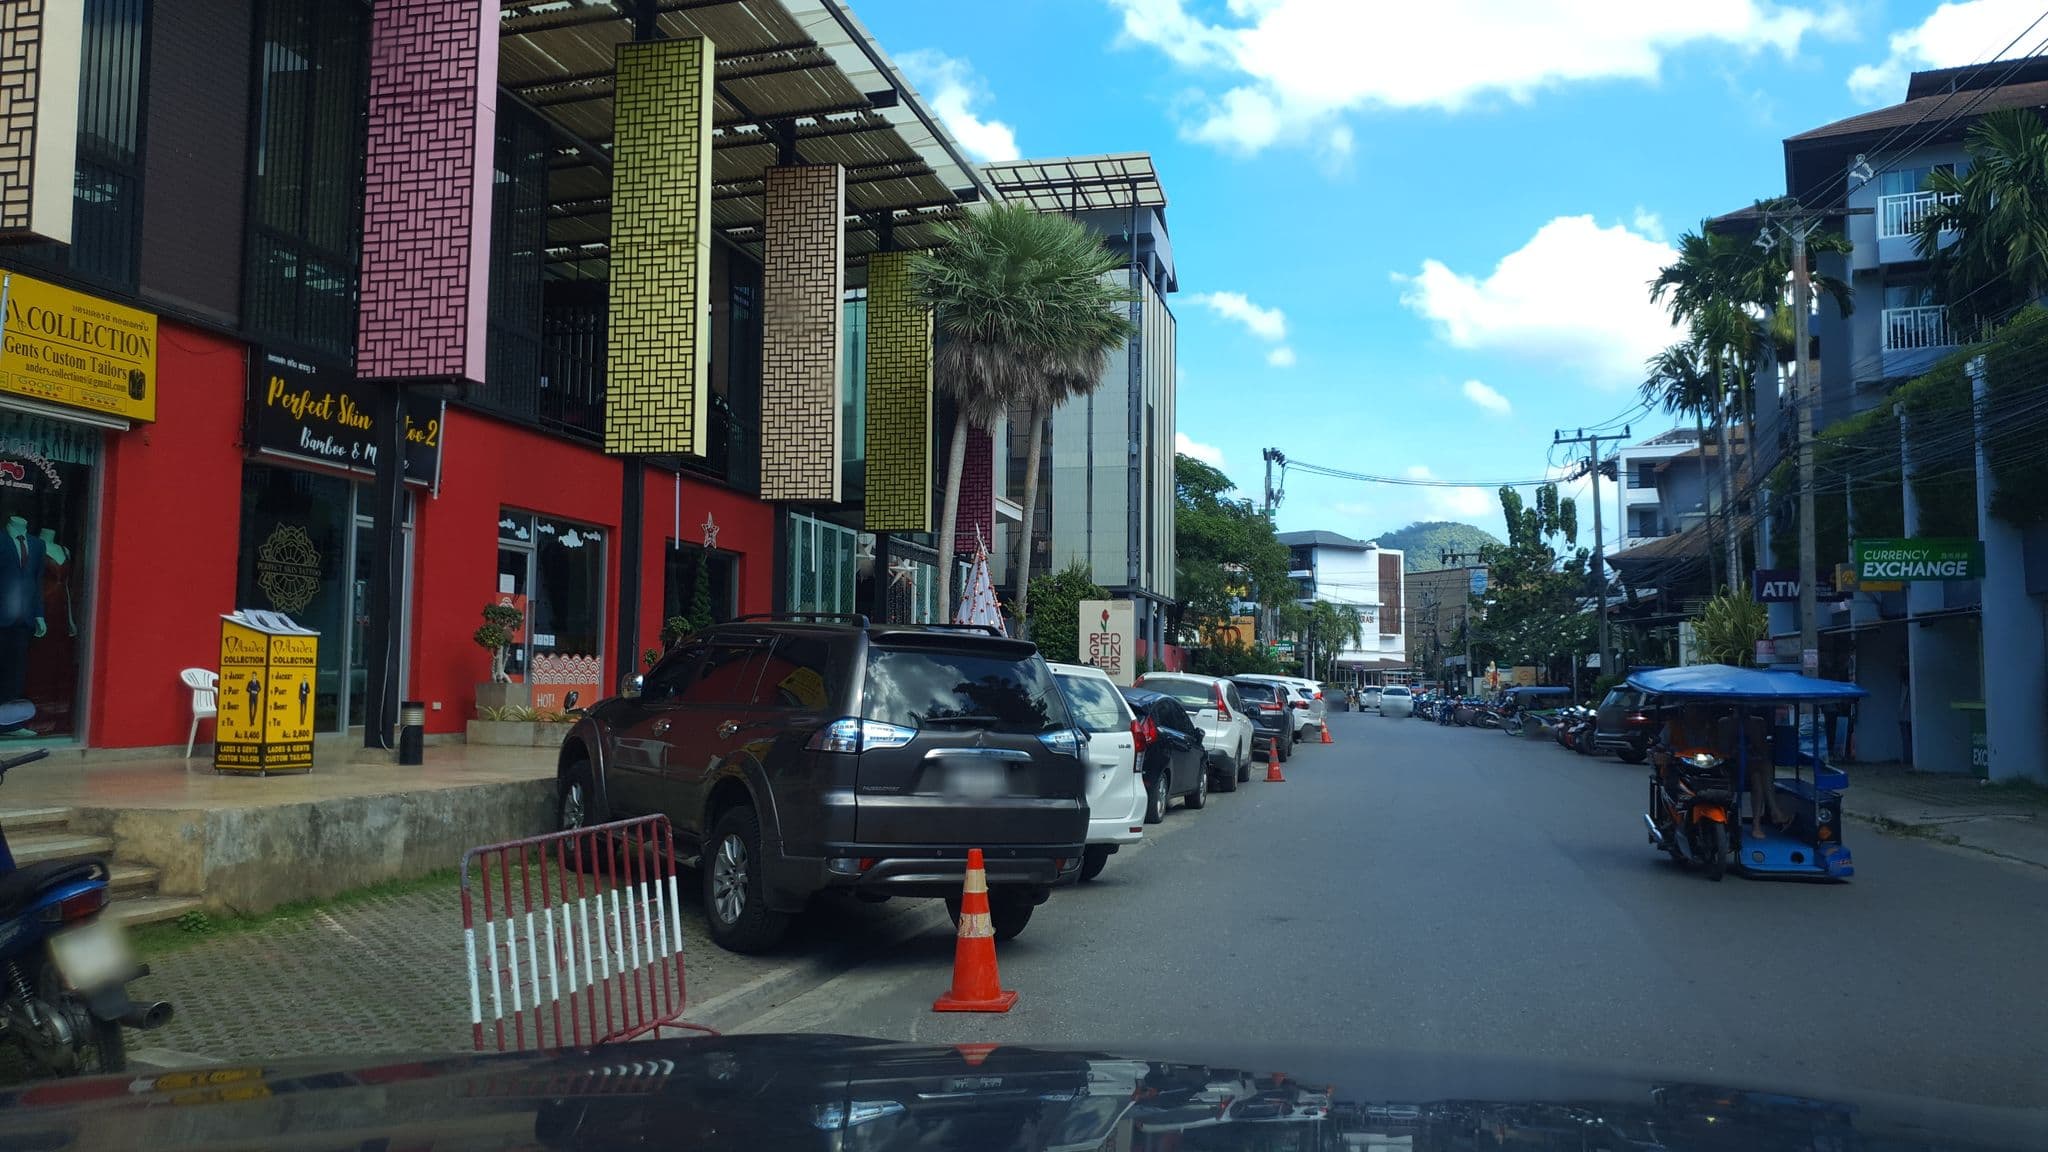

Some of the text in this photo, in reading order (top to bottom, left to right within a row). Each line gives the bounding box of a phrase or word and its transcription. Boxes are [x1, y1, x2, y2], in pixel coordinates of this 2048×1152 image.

[27, 306, 151, 359] COLLECTION
[4, 335, 128, 380] Gents Custom Tailors
[17, 375, 64, 391] Google
[267, 376, 335, 420] Perfect
[337, 394, 374, 430] Skin
[300, 426, 347, 456] Bamboo
[351, 442, 360, 460] &
[1863, 550, 1930, 561] CURRENCY
[1863, 561, 1968, 577] EXCHANGE
[1762, 581, 1801, 597] ATM
[1090, 632, 1121, 645] RED
[1089, 645, 1121, 656] GIN
[224, 656, 264, 665] COLLECTION
[273, 656, 314, 665] COLLECTION
[537, 693, 555, 708] HOT!
